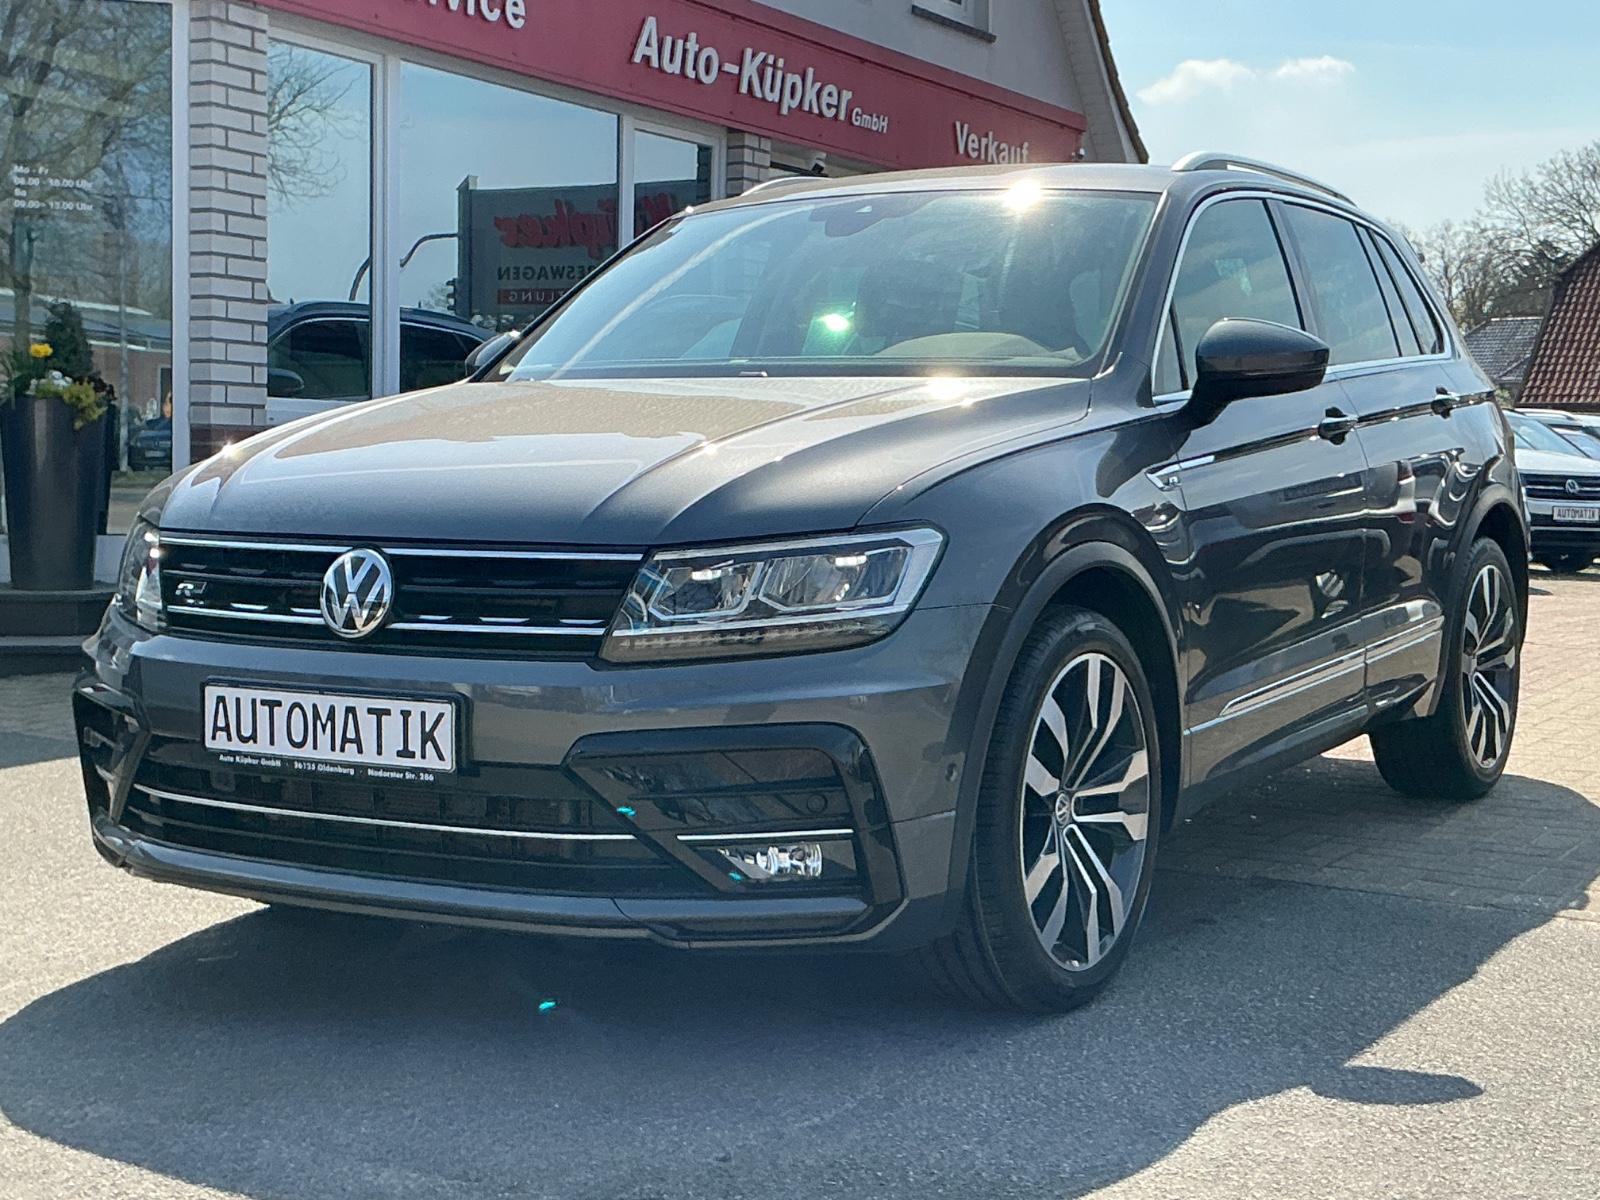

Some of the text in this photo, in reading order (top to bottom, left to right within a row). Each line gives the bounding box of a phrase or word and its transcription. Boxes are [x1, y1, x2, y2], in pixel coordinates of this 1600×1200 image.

[631, 16, 889, 134] Auto-Küpker GmbH
[955, 120, 1029, 164] Verkauf
[211, 695, 446, 762] AUTOMATIK
